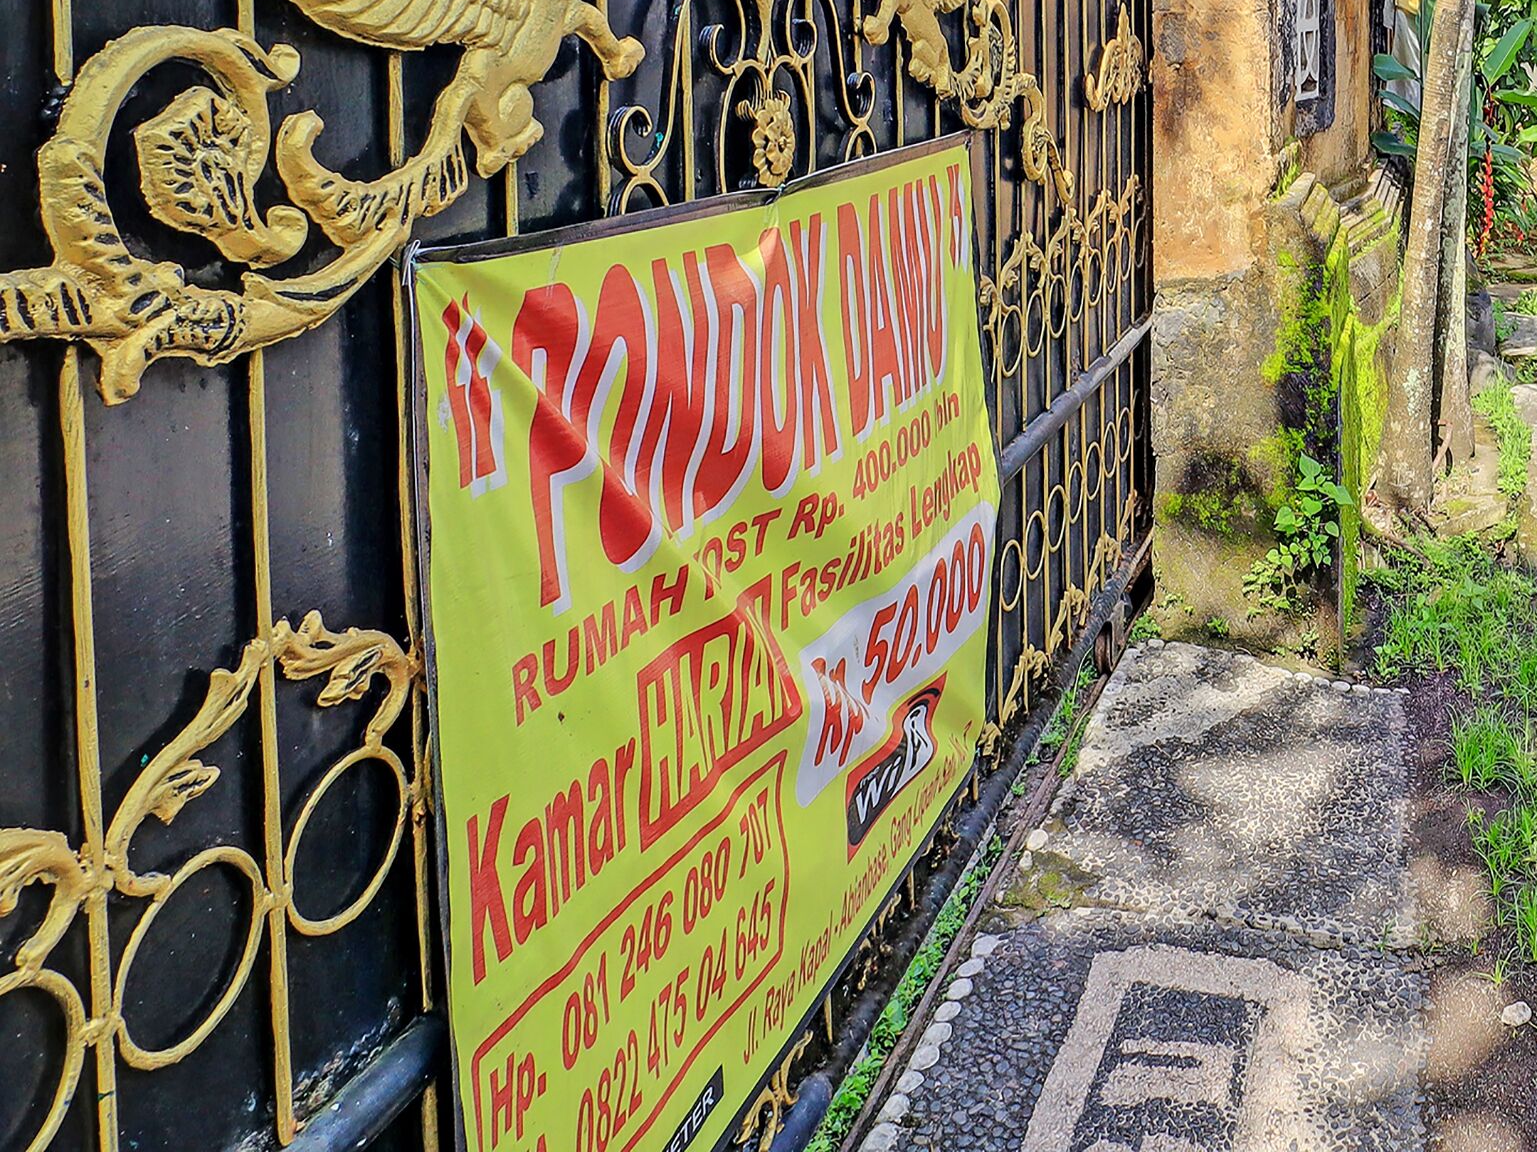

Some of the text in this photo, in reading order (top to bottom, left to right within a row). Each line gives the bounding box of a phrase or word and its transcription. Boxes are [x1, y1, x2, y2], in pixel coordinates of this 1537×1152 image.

[512, 563, 690, 728] RUMAH
[693, 508, 783, 601] OST
[787, 491, 844, 540] Rp.
[853, 409, 931, 501] 400.000
[781, 442, 981, 631] Fasilitas Lengkap
[466, 736, 636, 986] Kamar
[862, 522, 986, 705] 50.000
[489, 1051, 547, 1151] Hp.
[562, 951, 610, 1070] 081
[620, 890, 674, 1003] 246
[683, 836, 731, 935] 080
[739, 786, 772, 880] 707
[576, 877, 776, 1152] 0822 475 04 645
[763, 969, 796, 1039] Raya
[798, 910, 833, 993] Kapal
[890, 804, 912, 860] Gang
